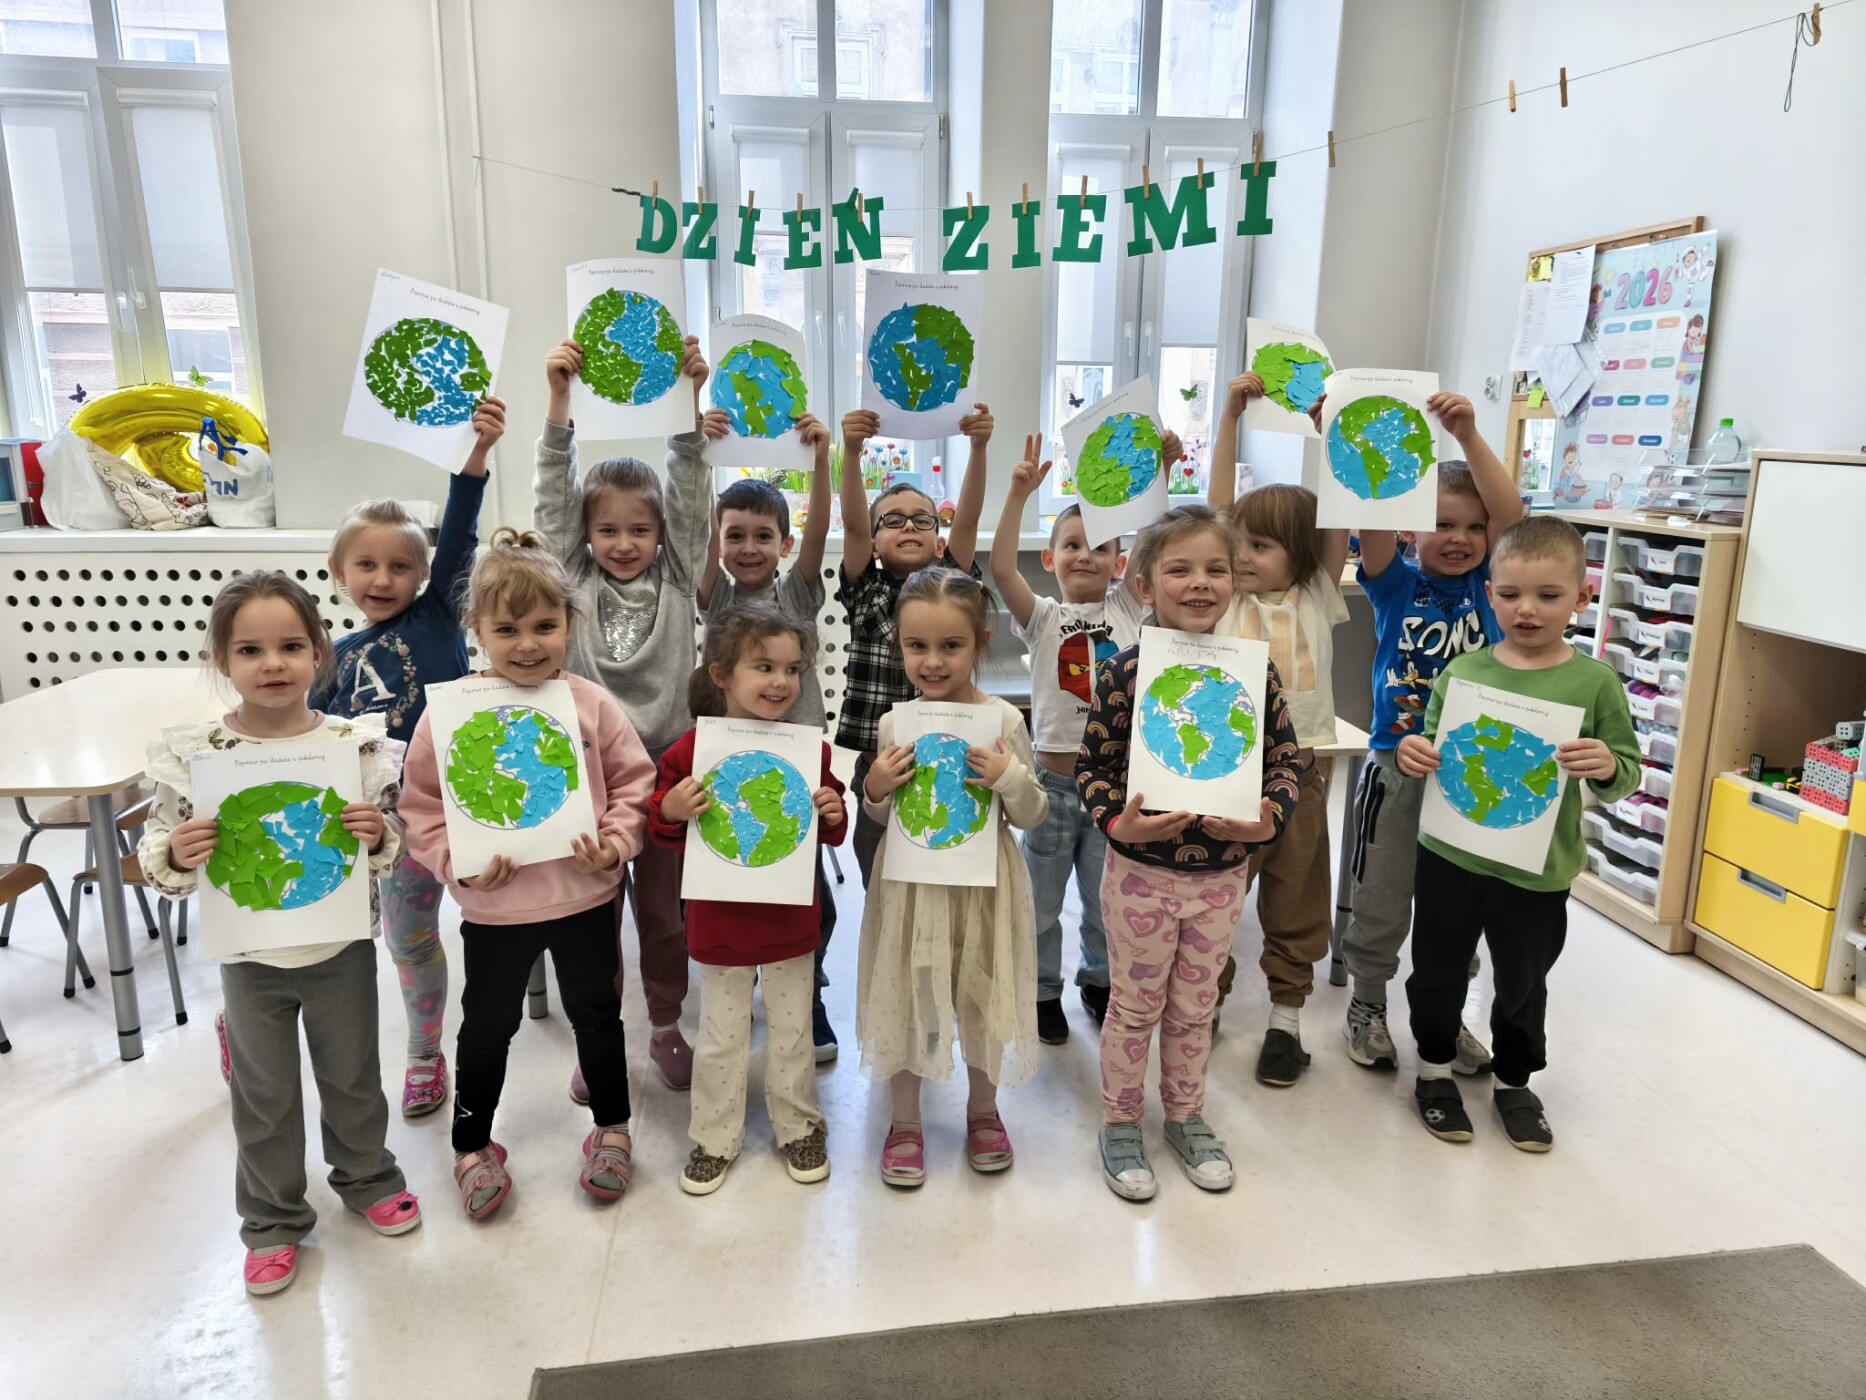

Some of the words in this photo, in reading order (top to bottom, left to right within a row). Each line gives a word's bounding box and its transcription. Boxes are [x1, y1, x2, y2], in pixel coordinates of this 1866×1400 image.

[636, 187, 884, 270] DZIEŃ
[942, 161, 1276, 271] ZIEMI
[1614, 266, 1673, 310] 2026
